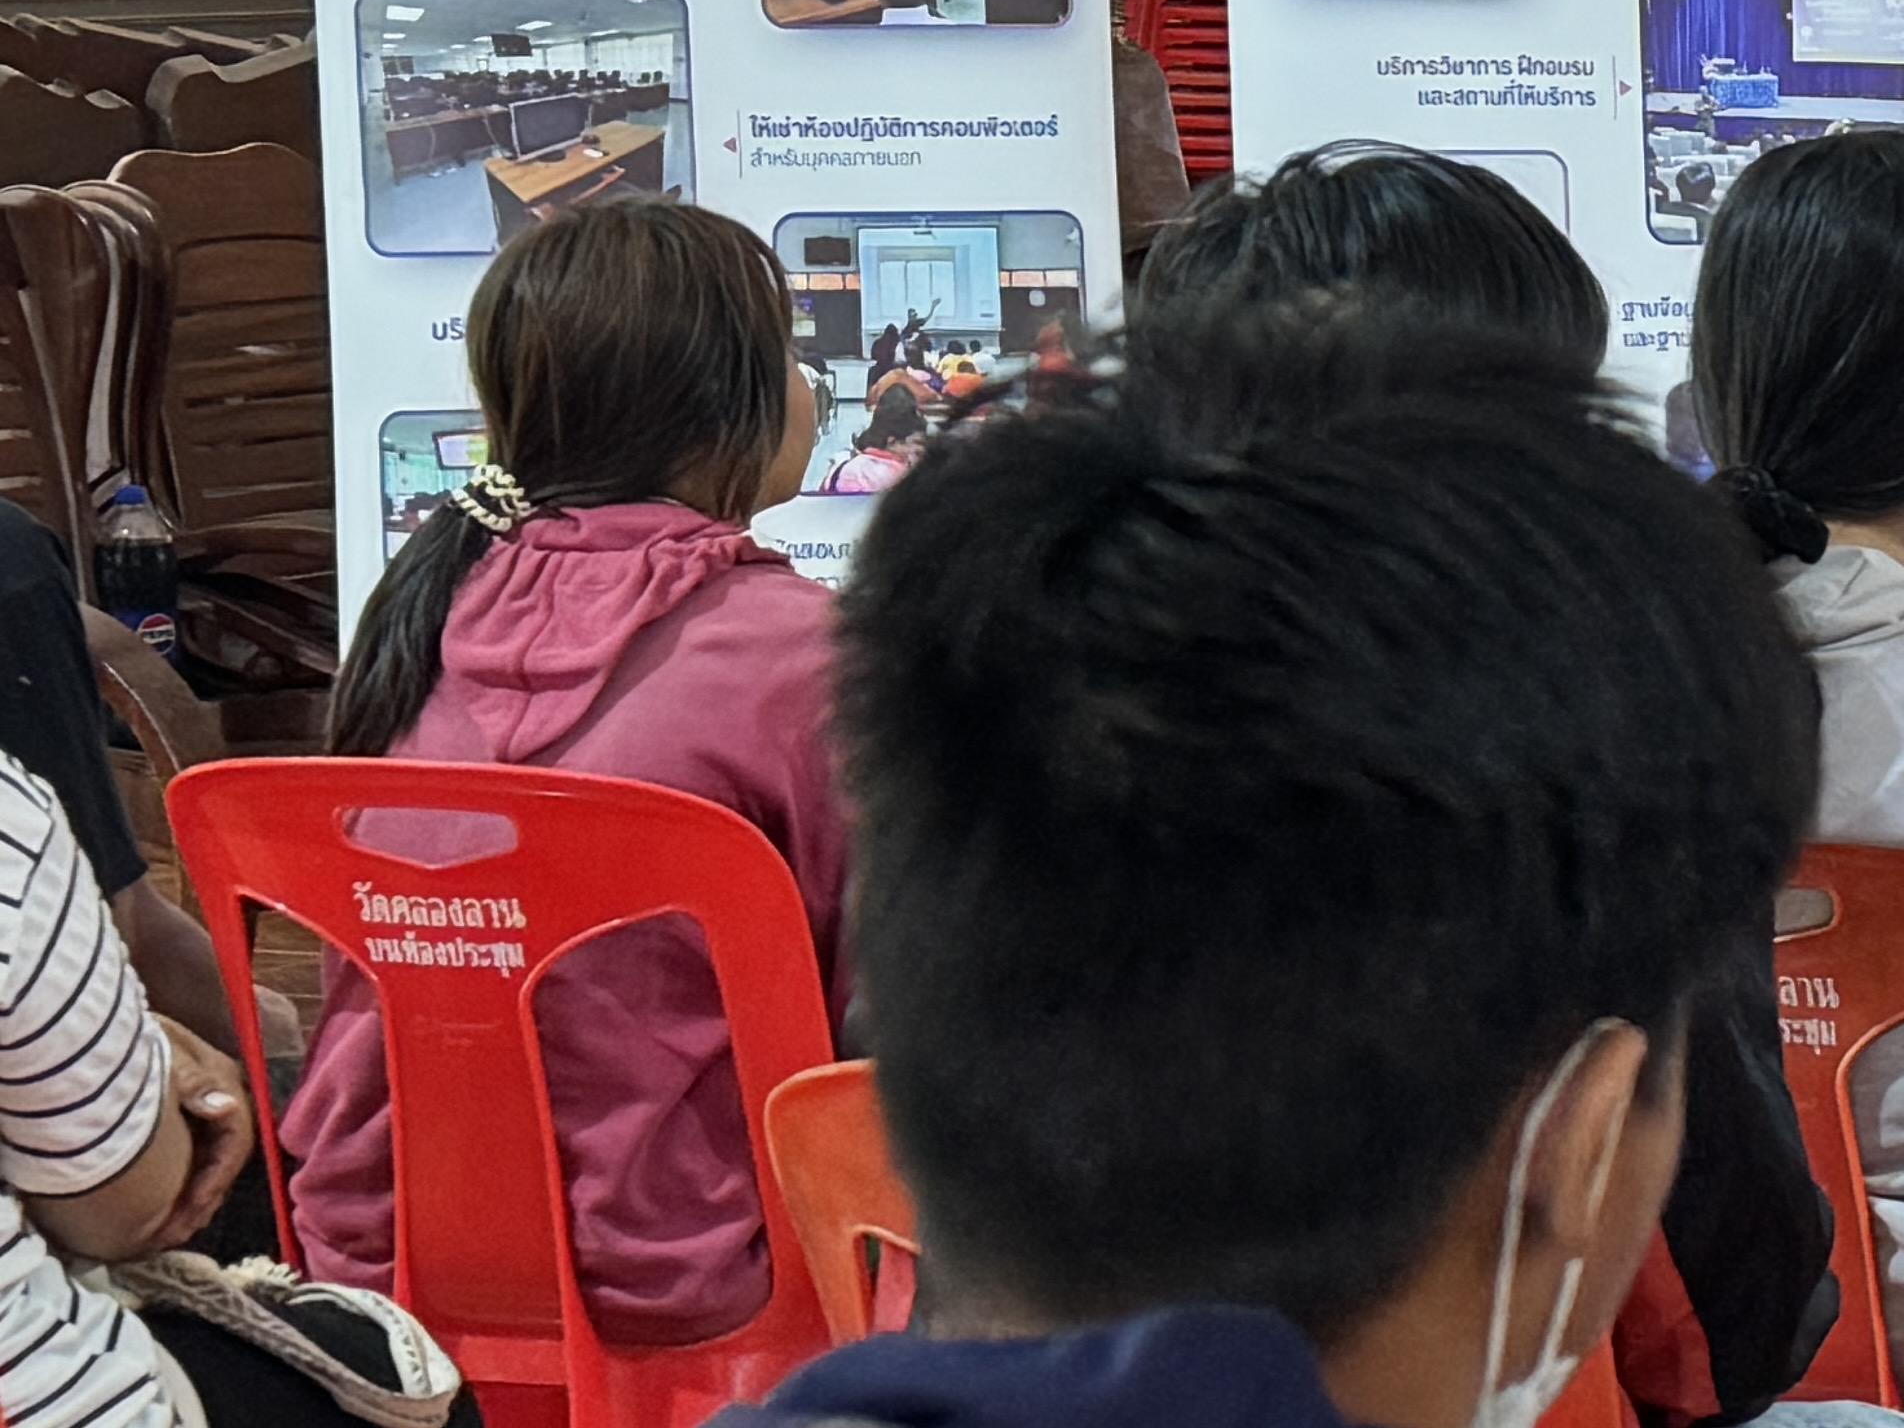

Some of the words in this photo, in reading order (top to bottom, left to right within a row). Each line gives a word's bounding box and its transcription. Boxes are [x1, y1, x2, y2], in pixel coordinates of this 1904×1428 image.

[1377, 56, 1513, 77] บริการวิชาการ
[1517, 55, 1595, 77] ฝึกอบรม
[1417, 78, 1597, 107] และสถานที่ให้บริการ
[749, 113, 1060, 142] ให้เช่าห้องปฏิบัติการคอมพิวเตอร์
[352, 881, 527, 930] วัดคลองลาน
[364, 931, 526, 978] บนห้องประชุม
